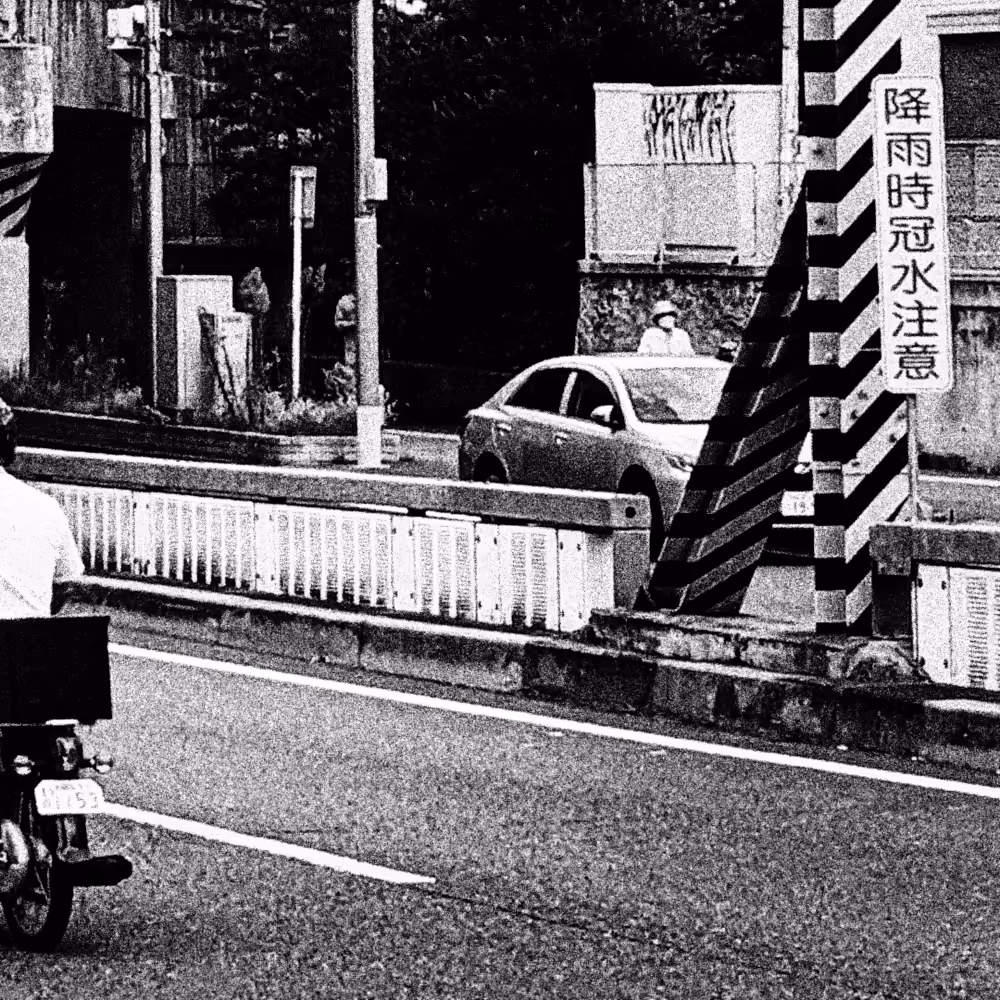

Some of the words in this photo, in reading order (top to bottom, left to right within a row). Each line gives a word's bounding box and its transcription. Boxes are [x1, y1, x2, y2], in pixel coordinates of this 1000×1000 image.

[884, 87, 939, 381] 降雨時冠水注意
